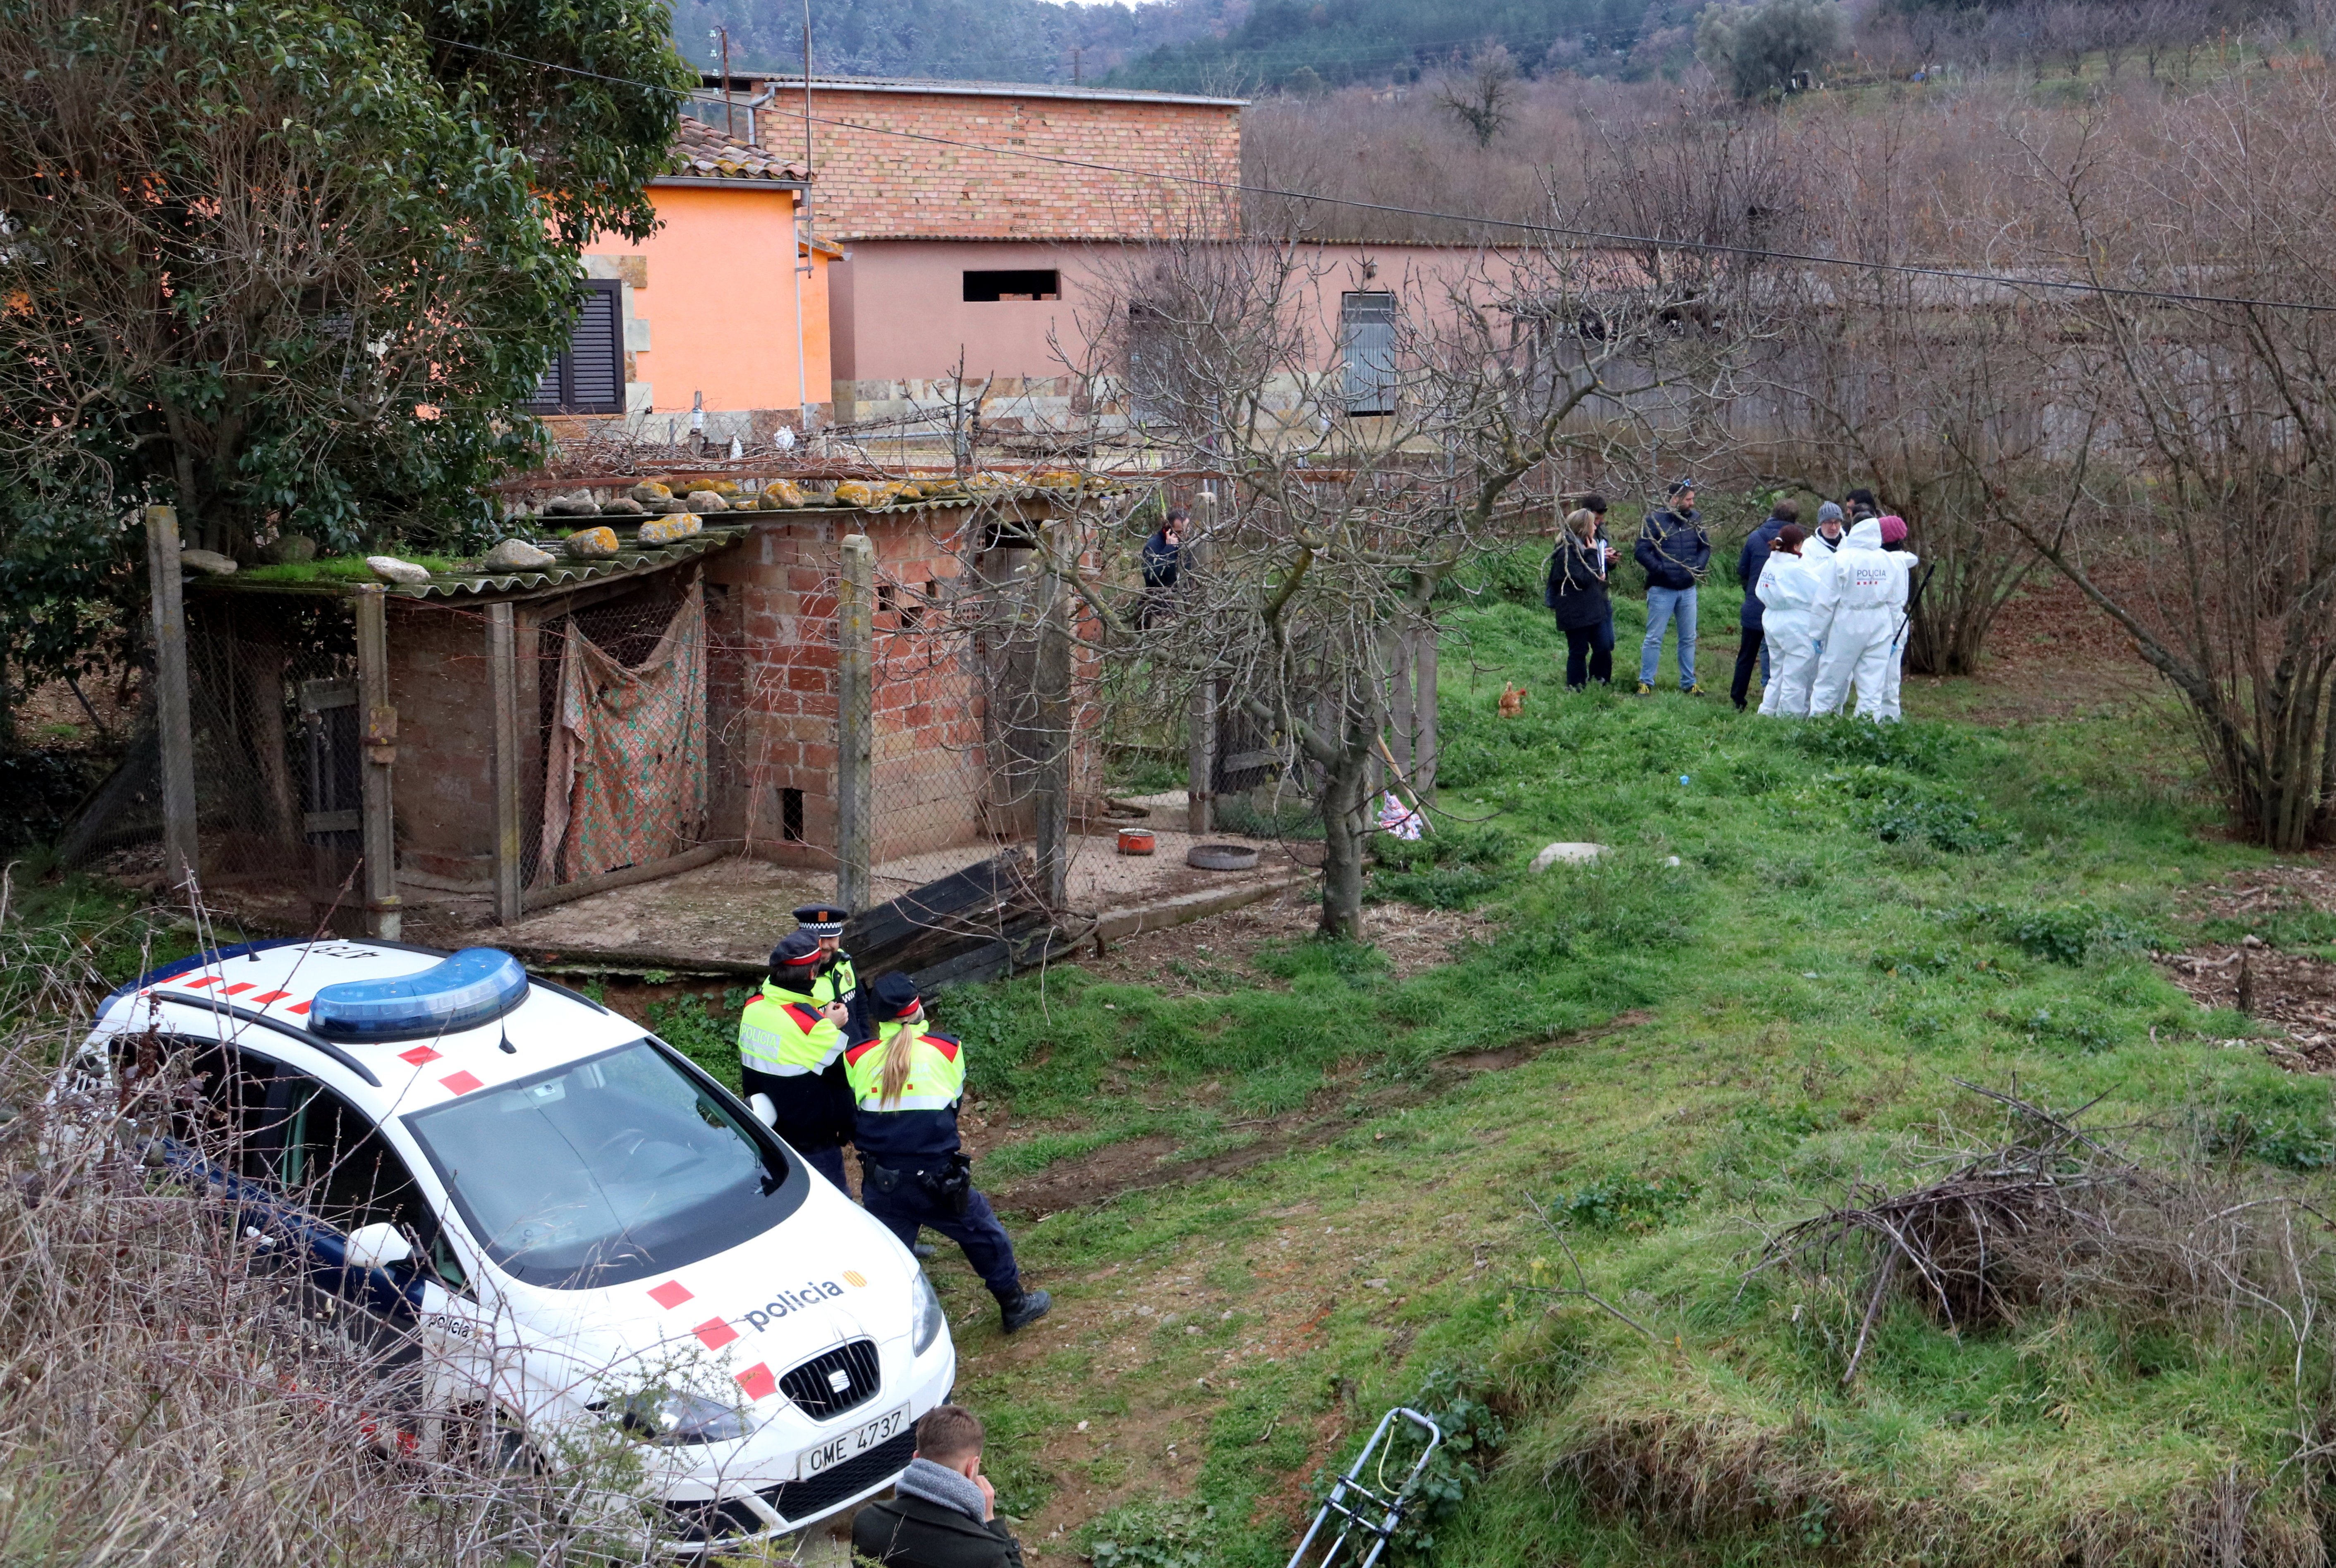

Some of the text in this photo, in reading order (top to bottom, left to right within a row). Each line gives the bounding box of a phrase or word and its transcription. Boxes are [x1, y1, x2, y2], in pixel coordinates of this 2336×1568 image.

[292, 944, 381, 959] 4737
[741, 1025, 777, 1049] POLICIA
[744, 1281, 845, 1332] policia
[857, 1410, 901, 1449] 4737
